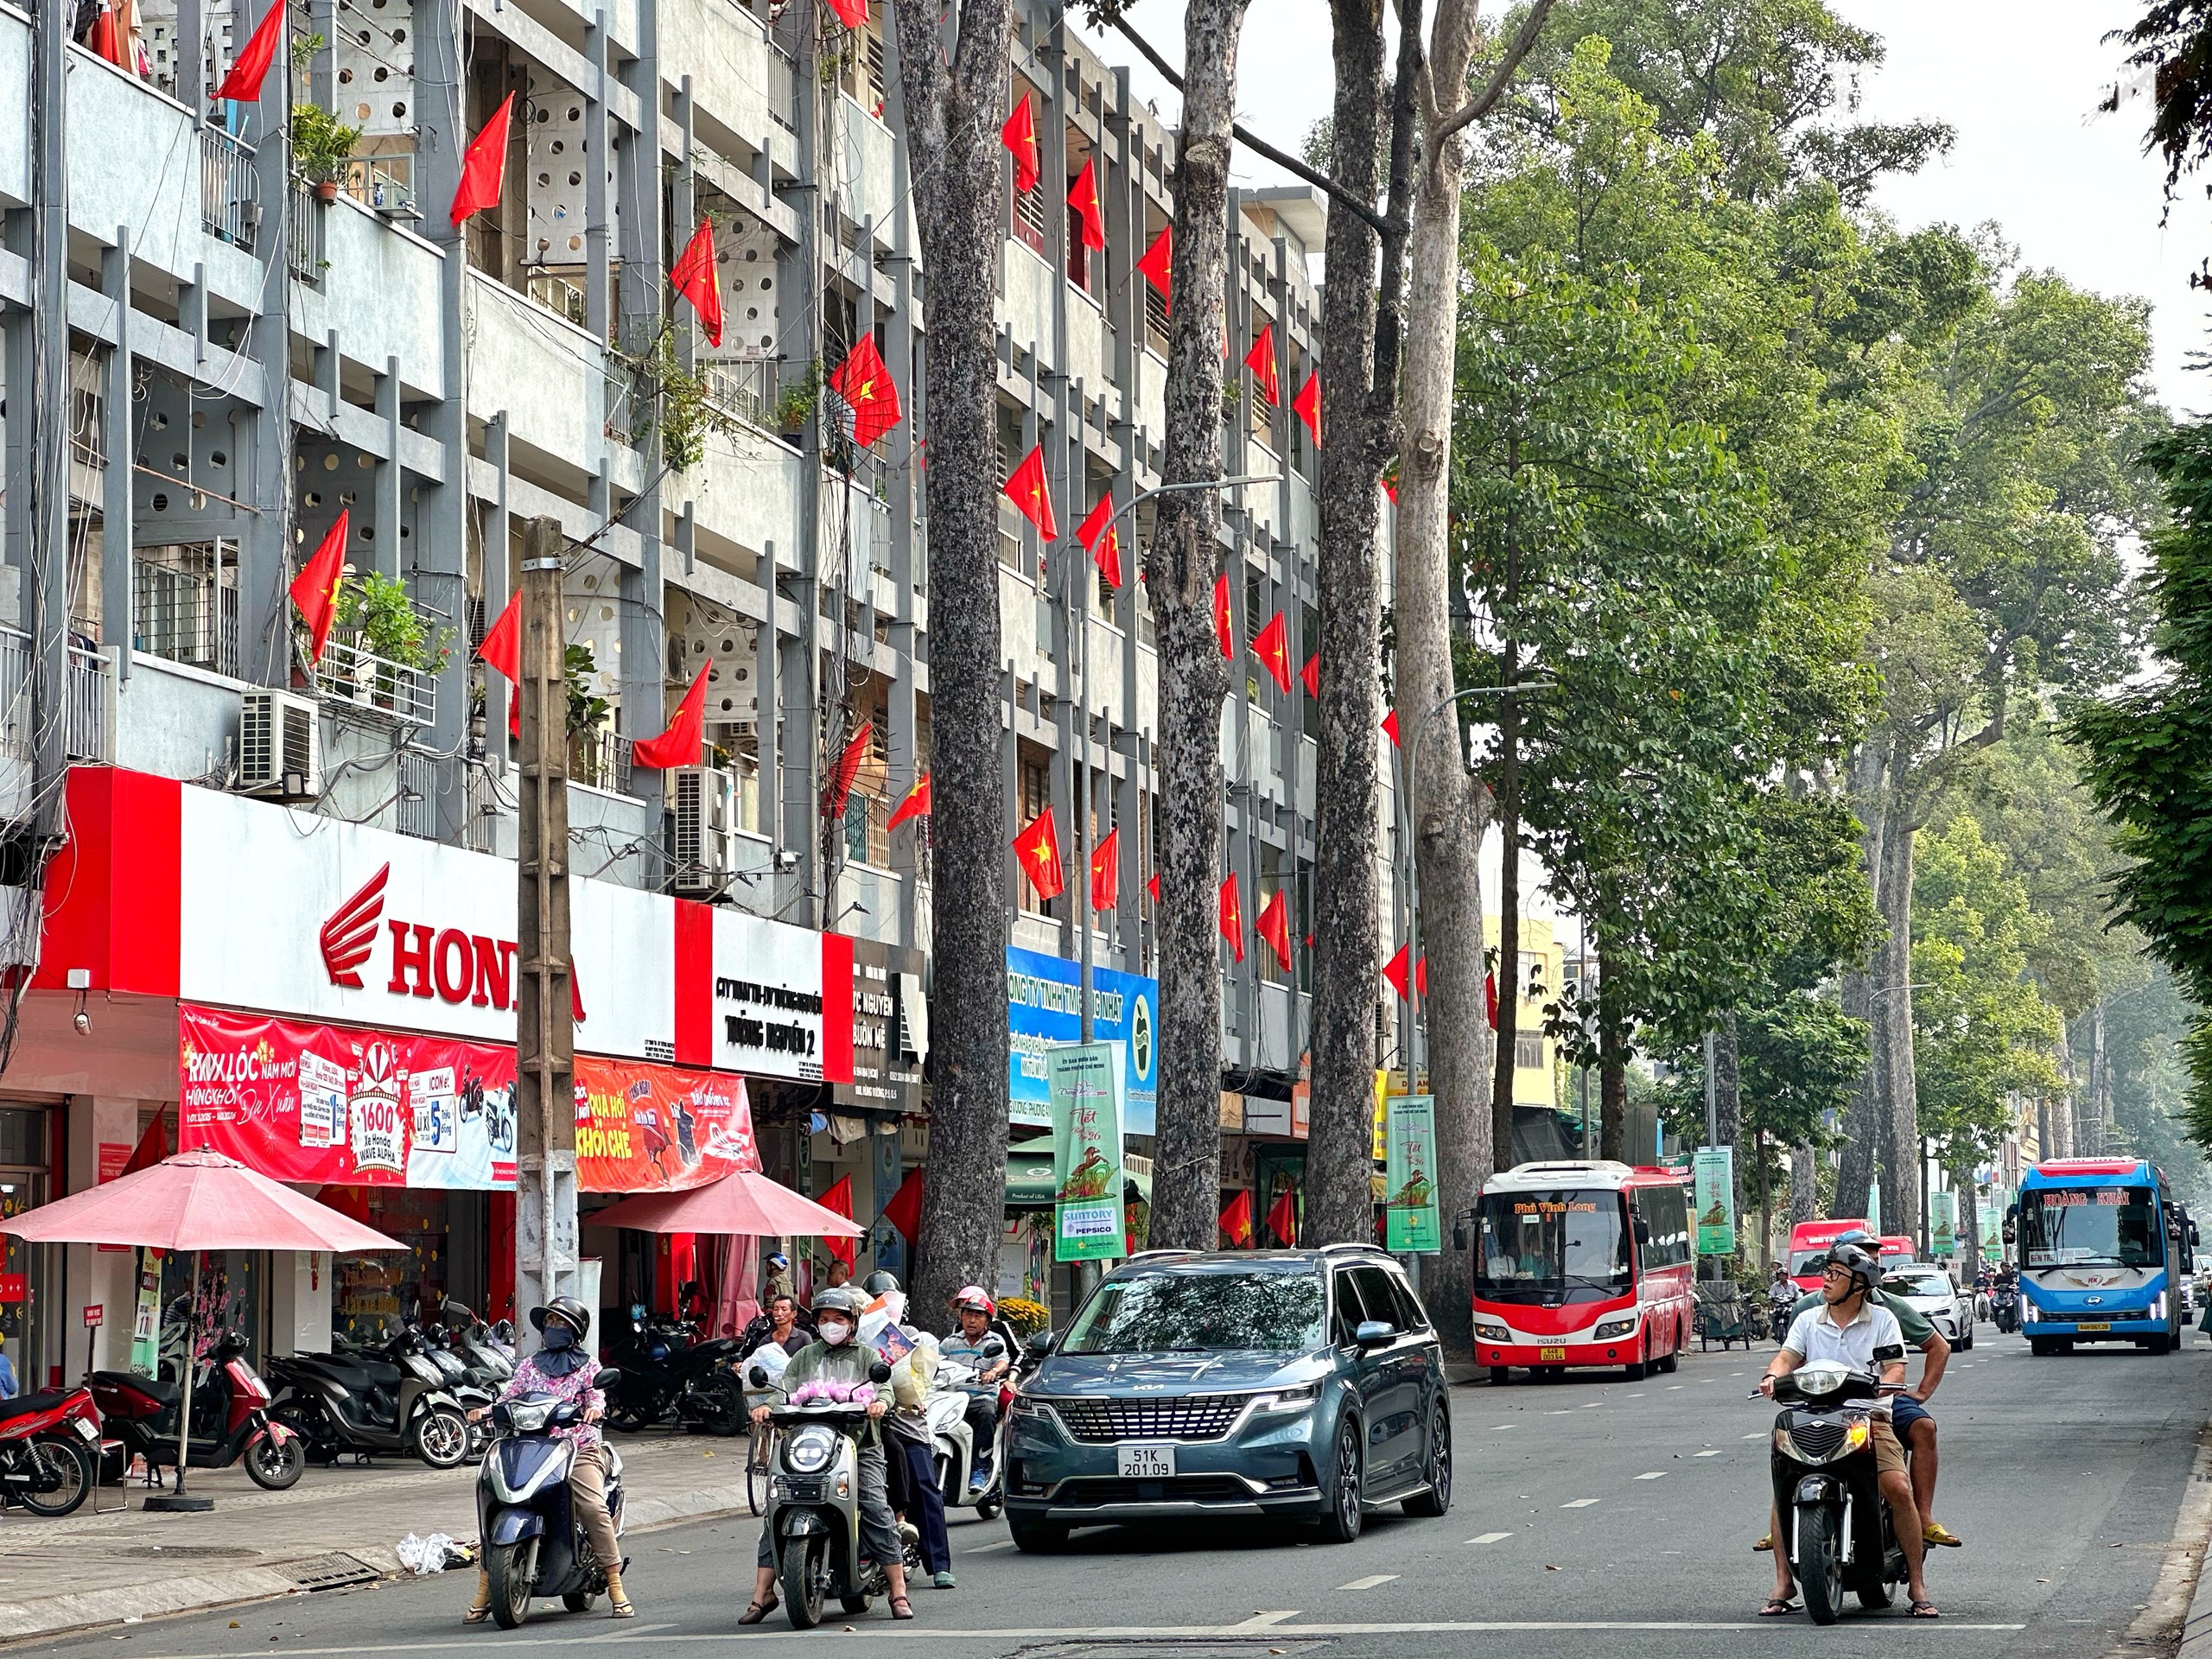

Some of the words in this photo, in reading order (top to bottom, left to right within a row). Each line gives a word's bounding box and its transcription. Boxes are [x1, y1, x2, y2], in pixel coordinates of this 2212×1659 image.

[388, 919, 586, 1022] HON
[863, 990, 893, 1017] NGUYÊN
[1008, 965, 1027, 1005] ÔNG
[1028, 975, 1039, 1007] TY
[1040, 979, 1063, 1012] TNHH
[1065, 983, 1077, 1015] TM
[1102, 988, 1122, 1027] NHẬT
[806, 1029, 815, 1057] 2
[226, 1045, 258, 1090] LỘC
[261, 1057, 278, 1080] NĂM
[280, 1054, 296, 1078] MỚI
[429, 1074, 443, 1091] ICON
[260, 1084, 295, 1122] Xuân
[588, 1086, 610, 1118] QUÀ
[360, 1102, 393, 1134] 1600
[431, 1100, 441, 1145] 5
[1070, 1107, 1099, 1126] Tết
[364, 1135, 372, 1147] Xe
[372, 1134, 391, 1147] Honda
[607, 1122, 632, 1160] CHÊ
[1088, 1131, 1101, 1141] 26
[359, 1147, 376, 1163] WAVE
[377, 1149, 396, 1165] ALPHA
[1515, 1203, 1537, 1213] Phú
[1568, 1201, 1596, 1213] Long
[2044, 1190, 2088, 1207] HOÀNG
[1076, 1226, 1111, 1235] PEPSICO
[1134, 1450, 1158, 1462] 51K
[1124, 1464, 1168, 1476] 201.09
